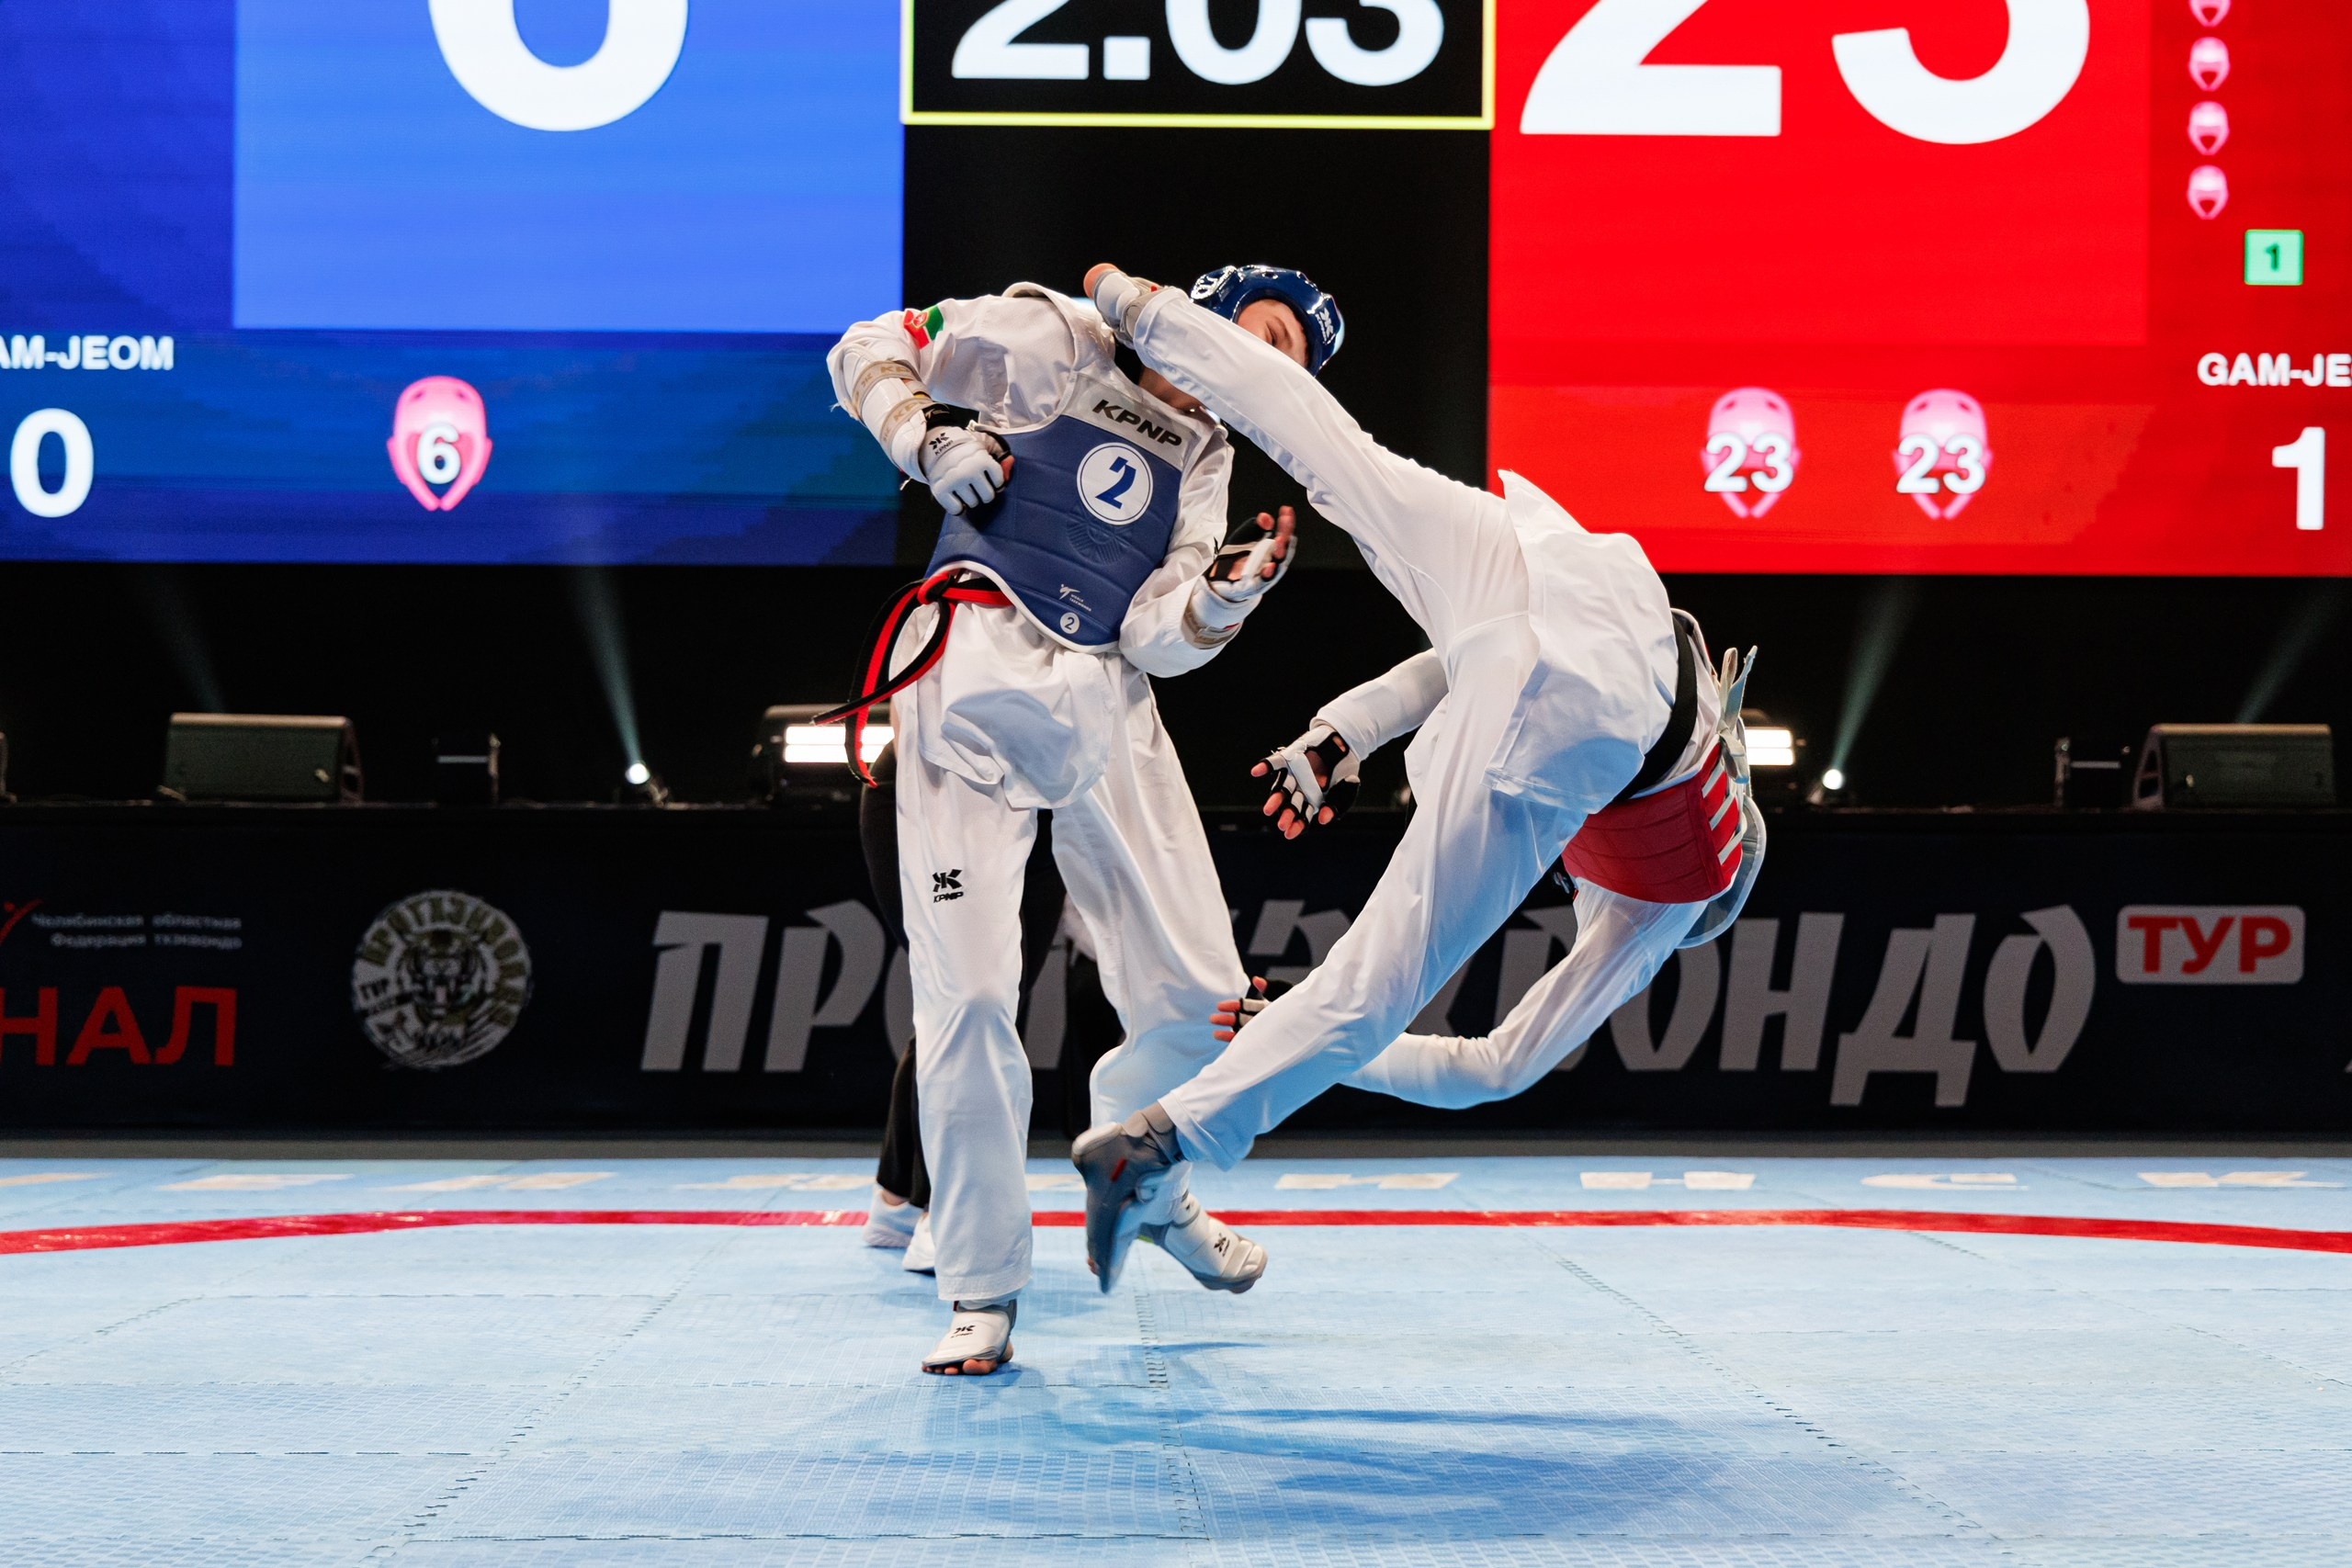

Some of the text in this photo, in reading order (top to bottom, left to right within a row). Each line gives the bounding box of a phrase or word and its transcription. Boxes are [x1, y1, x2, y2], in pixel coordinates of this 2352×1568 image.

[2265, 243, 2280, 271] 1
[2198, 353, 2352, 387] GAM-JE
[1092, 399, 1182, 446] KPNP
[10, 407, 95, 518] 0
[417, 423, 461, 485] 6
[1094, 456, 1136, 510] 2
[1703, 433, 1794, 493] 23
[1895, 434, 1986, 494] 23
[2272, 426, 2325, 530] 1
[1064, 616, 1075, 630] 2
[2127, 916, 2291, 974] ТУР
